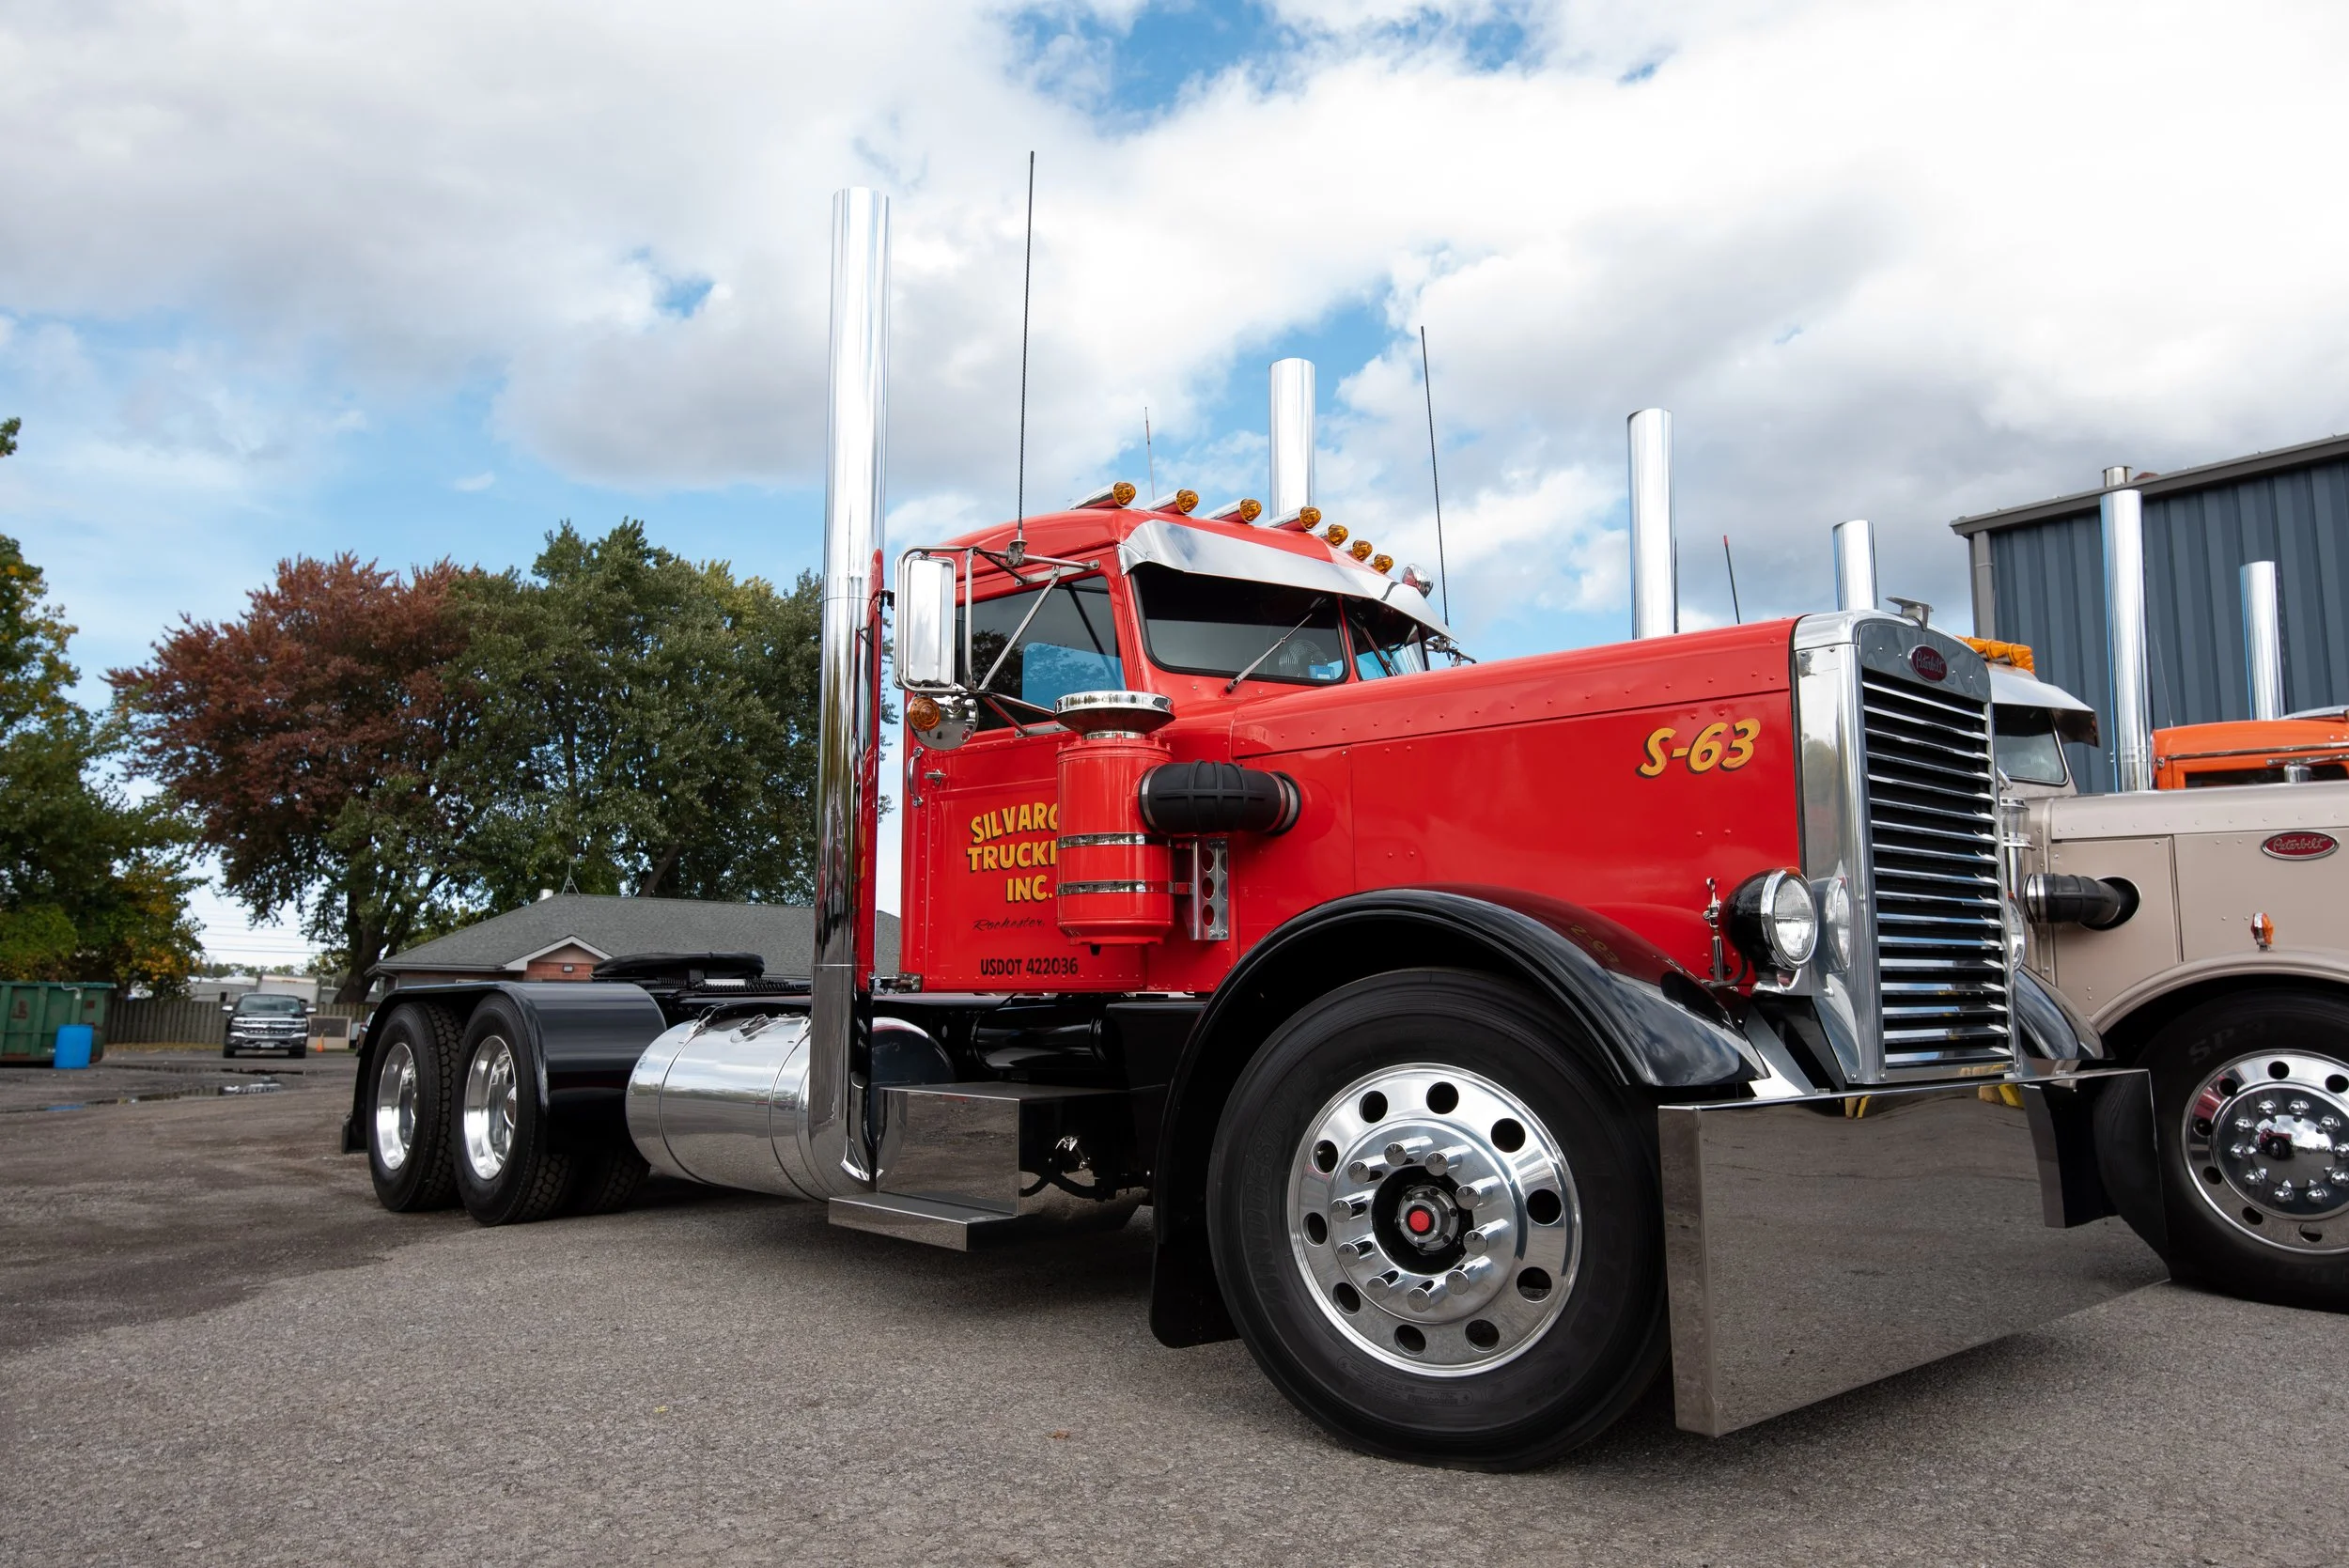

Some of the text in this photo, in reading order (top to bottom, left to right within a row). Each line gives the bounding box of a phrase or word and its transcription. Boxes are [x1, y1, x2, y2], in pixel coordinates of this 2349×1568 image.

[1635, 718, 1761, 778] S-63
[966, 840, 1057, 874] TRUCKI
[2273, 837, 2328, 852] Peterbilt
[1005, 875, 1053, 904] INC.
[980, 956, 1078, 975] USDOT 422036
